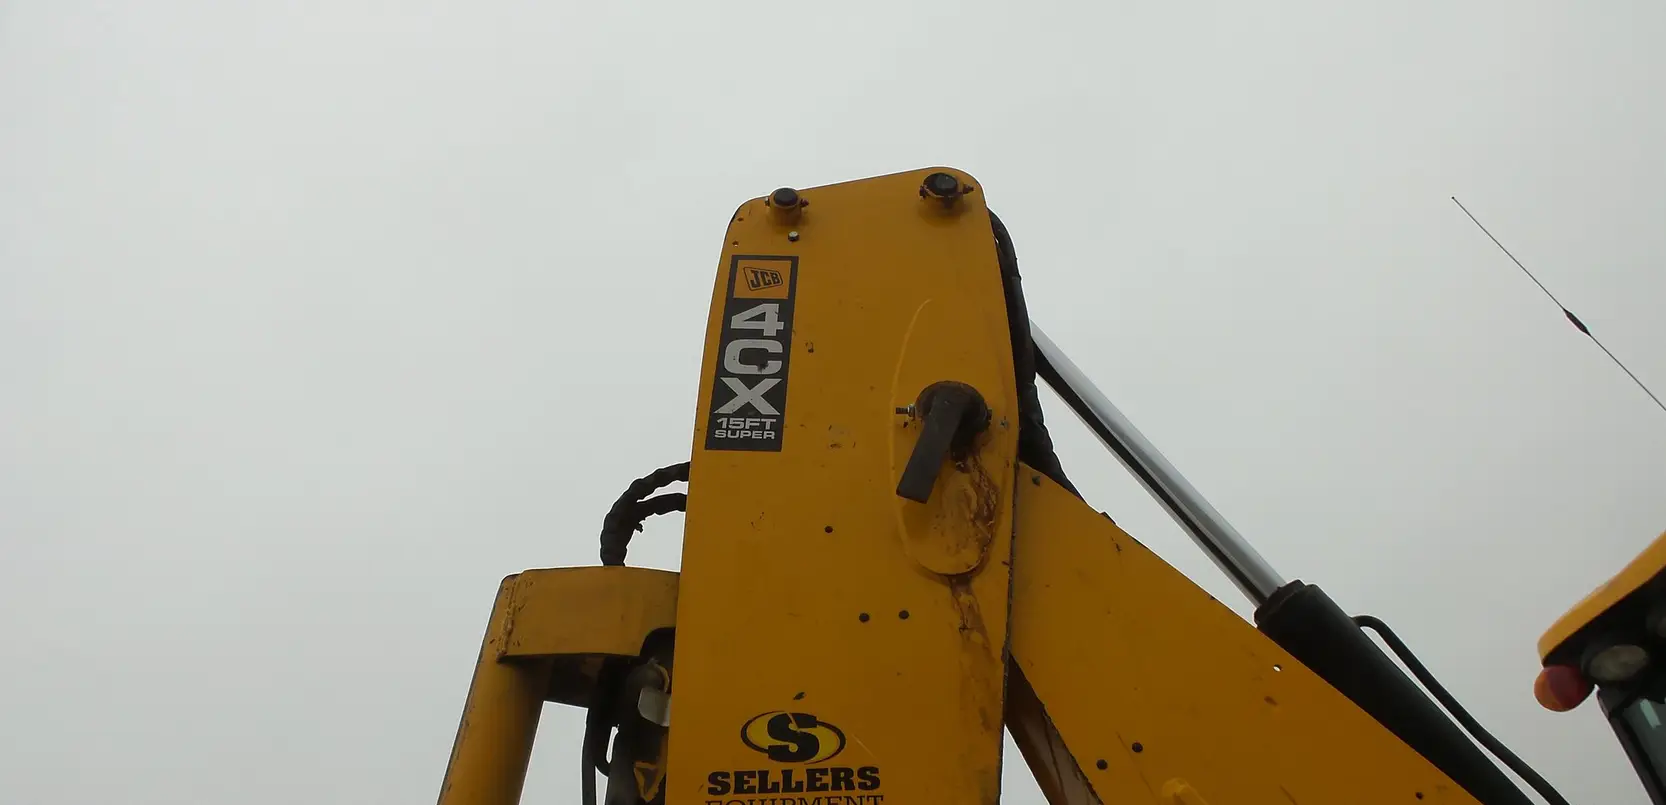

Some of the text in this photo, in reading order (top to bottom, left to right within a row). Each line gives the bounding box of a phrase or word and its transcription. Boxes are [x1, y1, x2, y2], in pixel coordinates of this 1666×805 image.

[749, 269, 782, 289] JCB
[714, 303, 785, 415] 4CX
[714, 430, 776, 440] SUPER
[716, 417, 777, 430] 15FT
[767, 712, 820, 763] S
[707, 766, 881, 796] SELLERS
